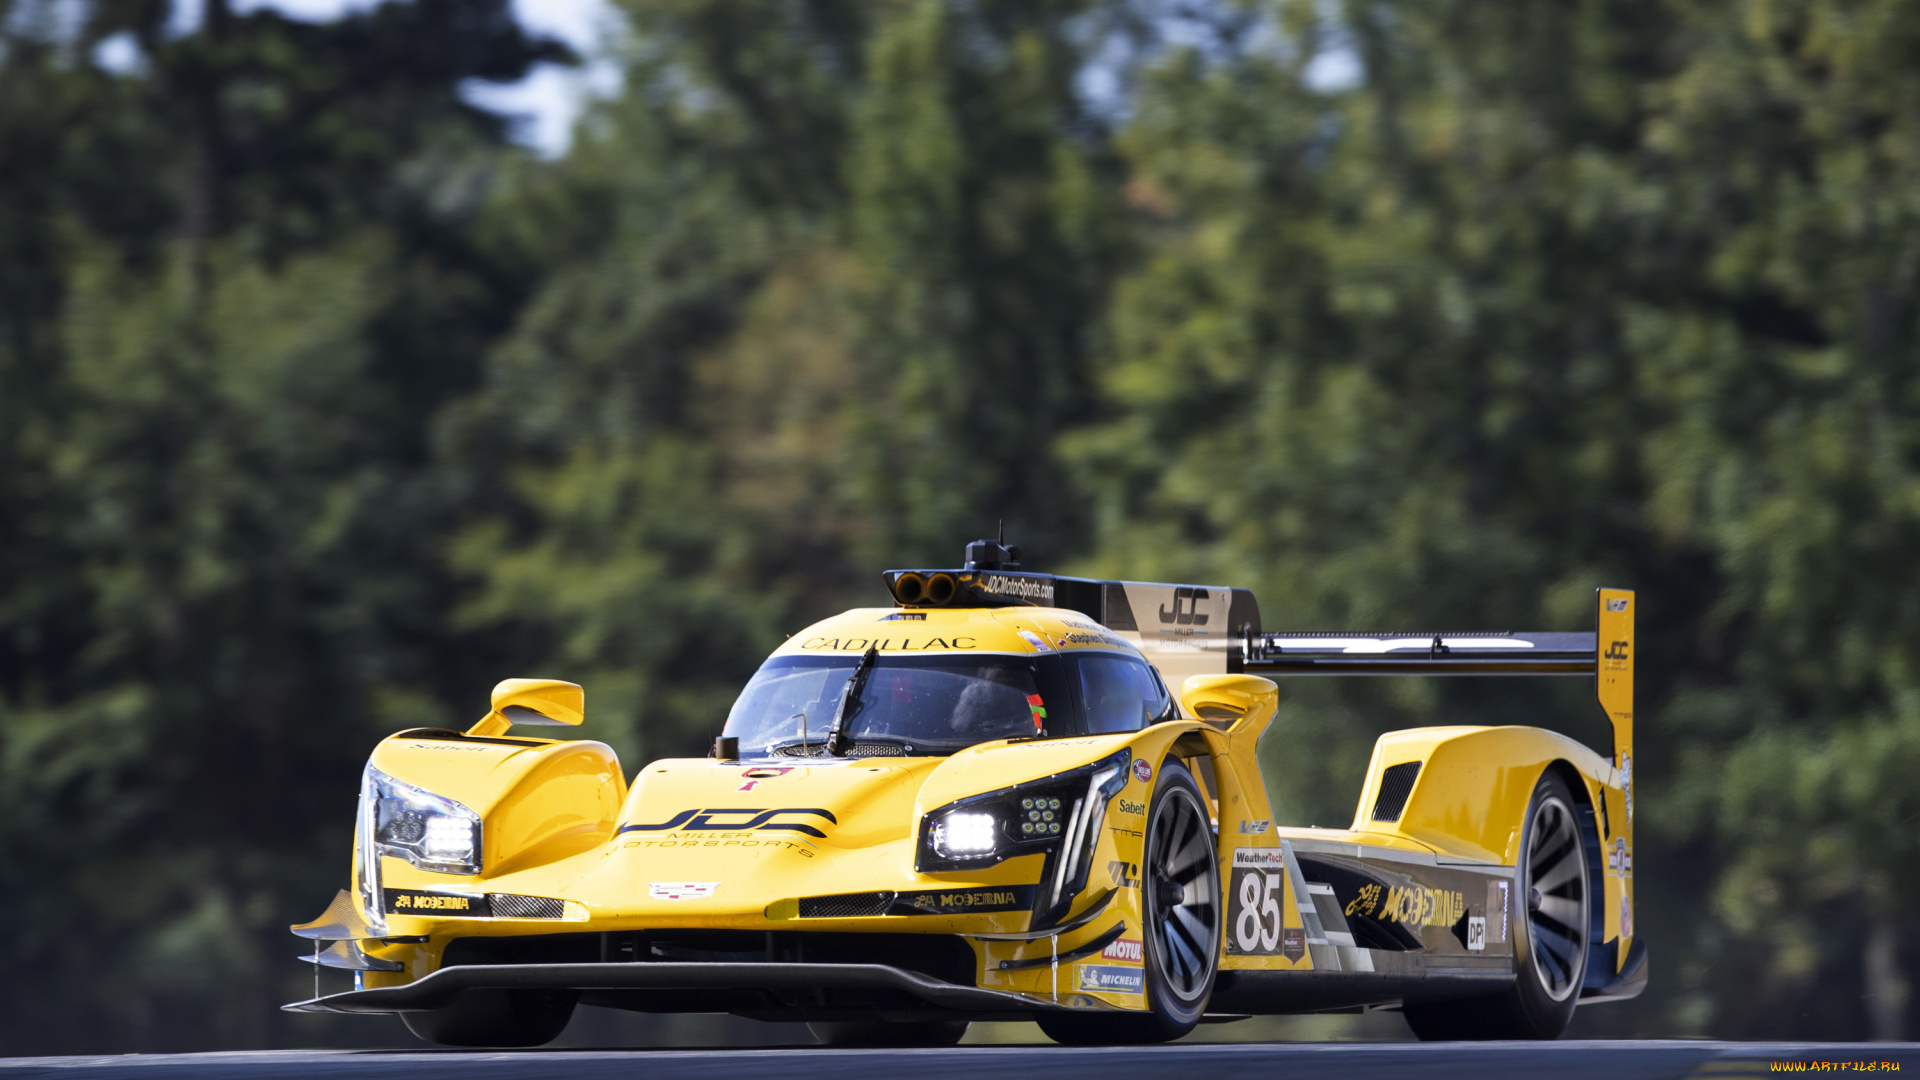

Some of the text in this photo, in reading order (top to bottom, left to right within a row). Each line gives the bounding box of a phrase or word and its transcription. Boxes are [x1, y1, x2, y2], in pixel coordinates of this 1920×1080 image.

[984, 575, 1054, 600] JDCMotorSports.com
[1159, 587, 1210, 626] JDC
[1174, 628, 1194, 637] MILLER
[801, 637, 977, 651] CADILLAC
[1119, 799, 1146, 816] Sabelt
[665, 832, 753, 840] MILLER
[1236, 852, 1283, 863] WeatherTech
[940, 892, 1016, 907] MODERNA
[1236, 872, 1280, 952] 85
[1103, 940, 1142, 960] MOTUL
[1100, 974, 1141, 987] MICHELIN
